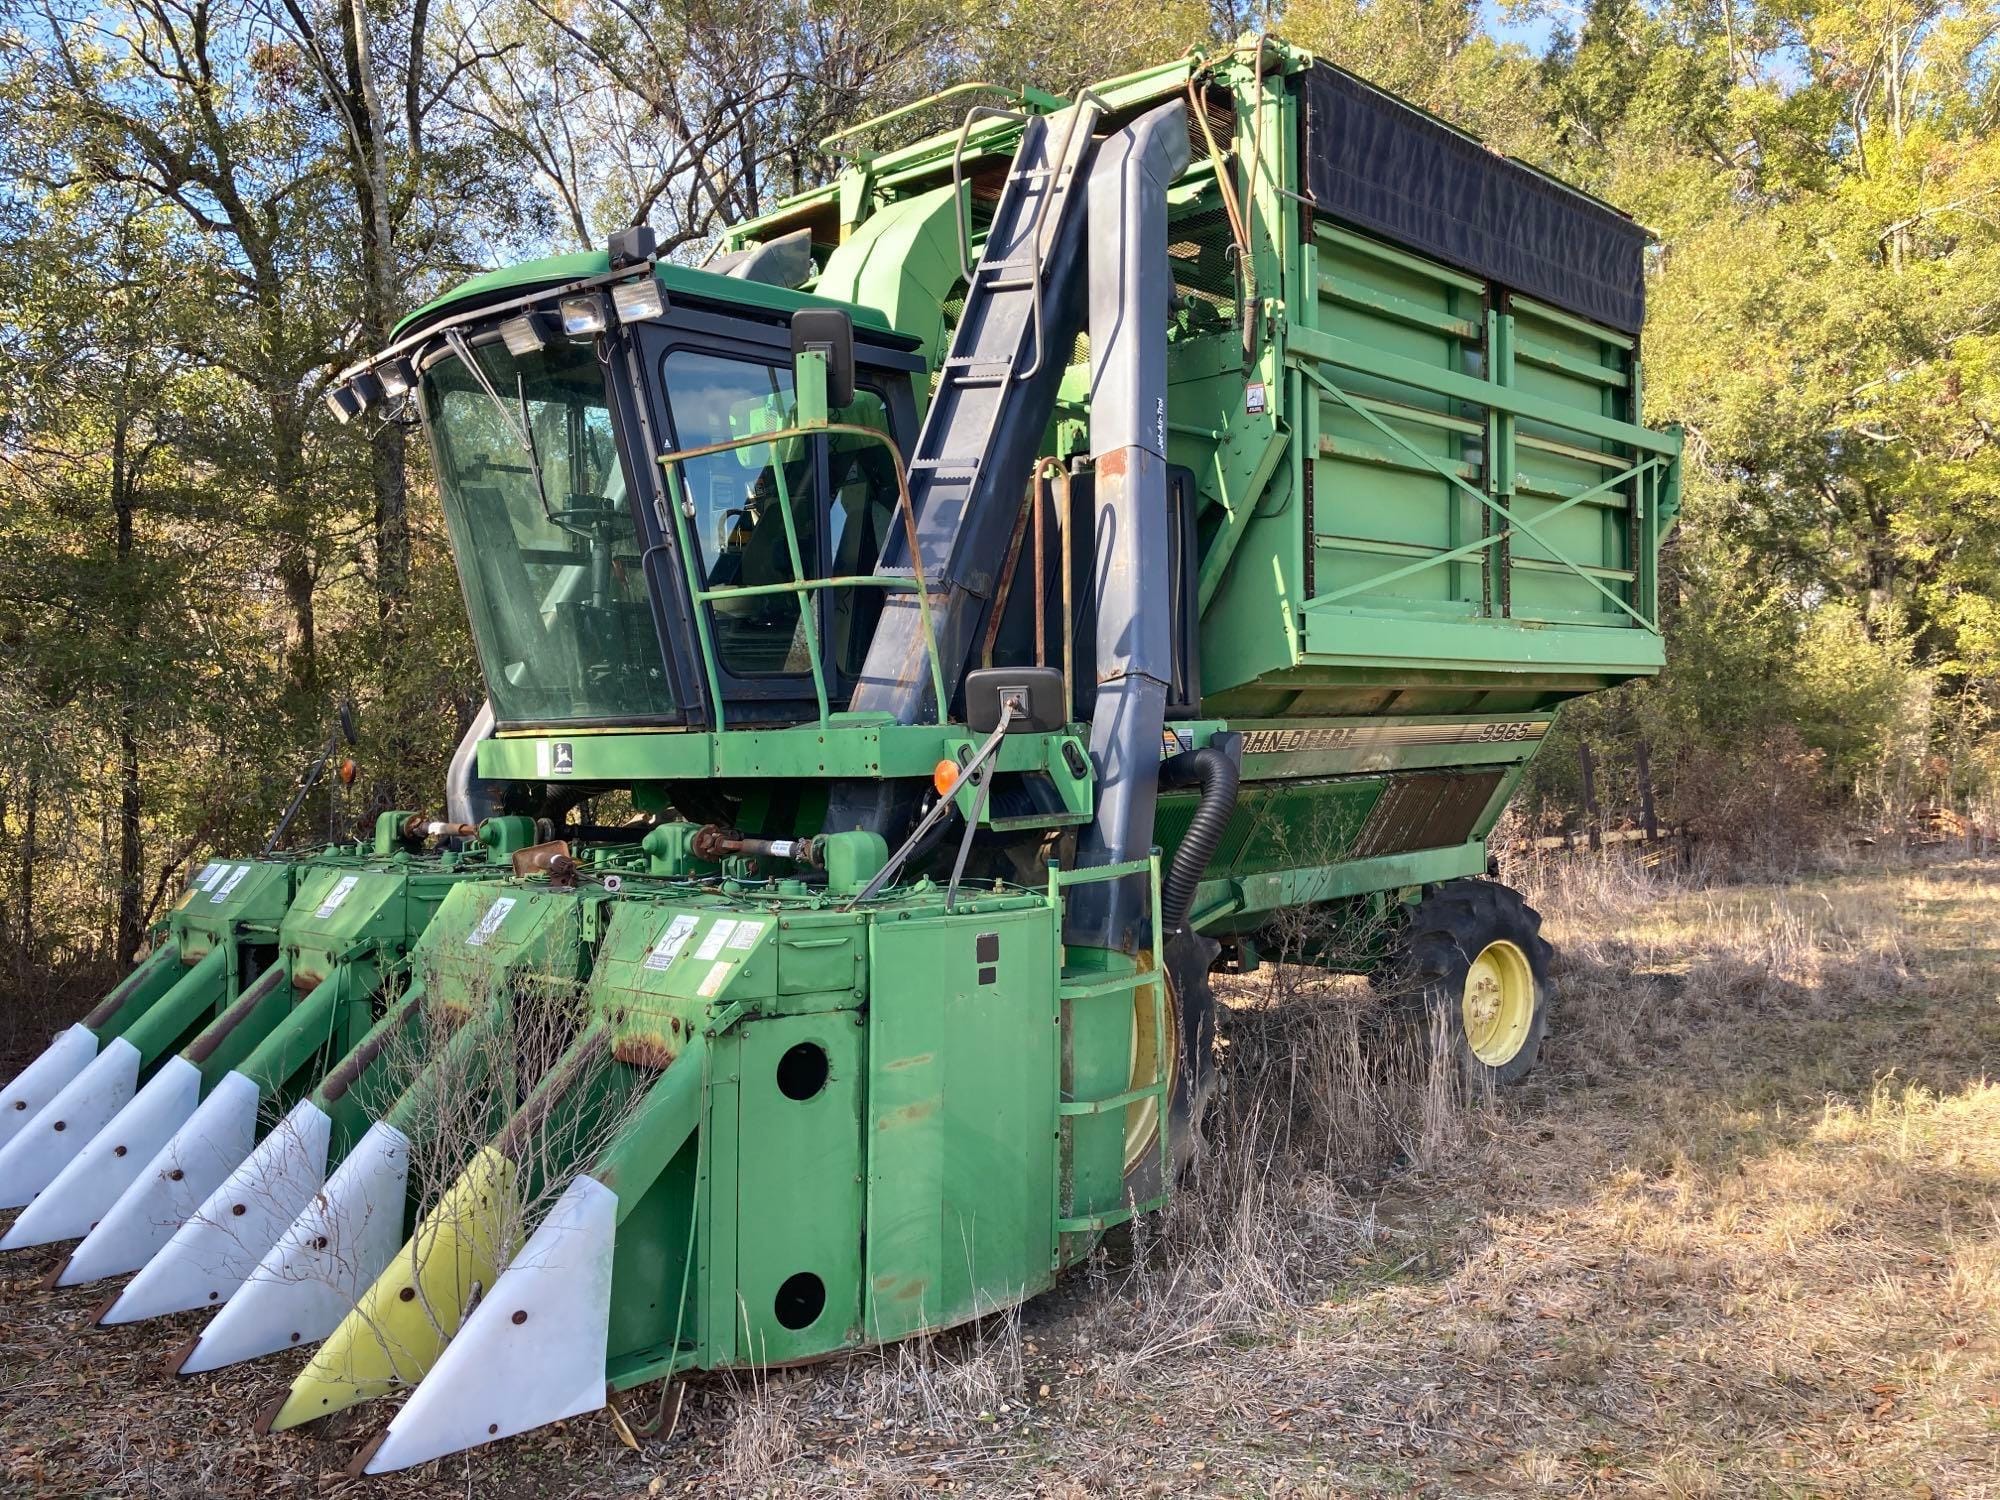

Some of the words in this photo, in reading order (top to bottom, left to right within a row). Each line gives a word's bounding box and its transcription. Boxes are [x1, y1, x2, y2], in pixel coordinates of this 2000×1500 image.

[1241, 730, 1286, 753] OHN
[1286, 727, 1357, 750] DEERE
[1478, 722, 1532, 742] 9965
